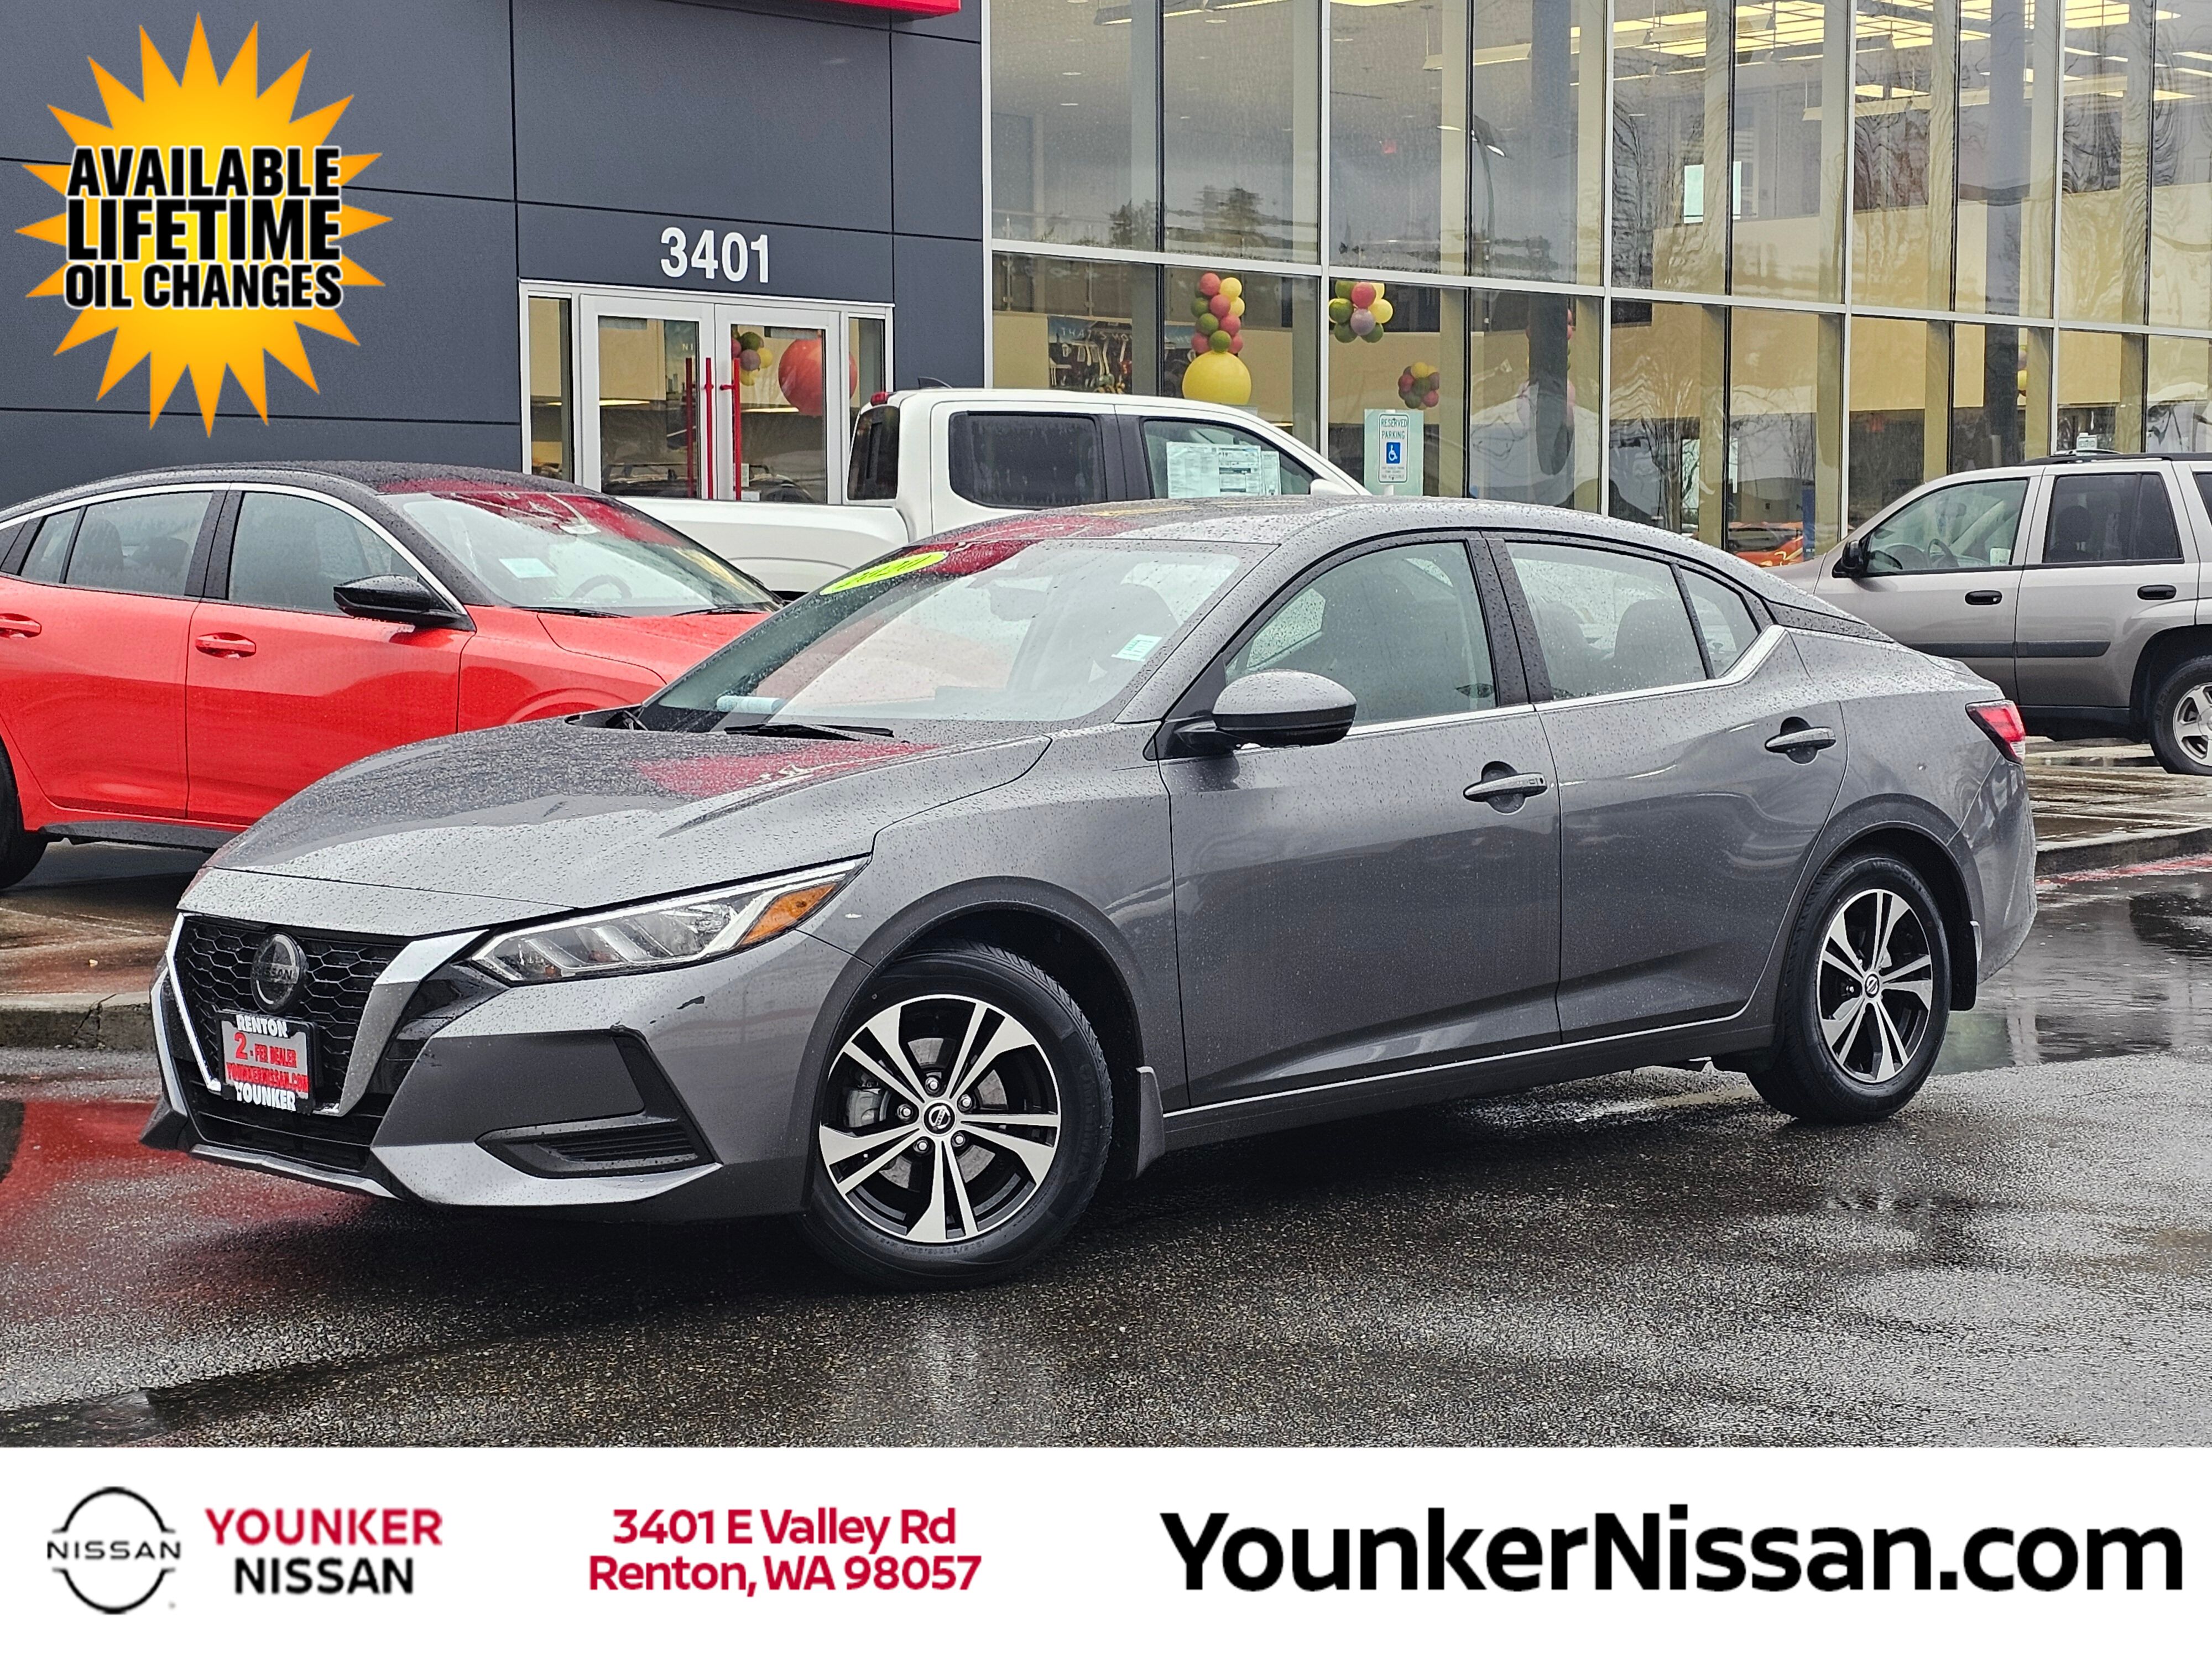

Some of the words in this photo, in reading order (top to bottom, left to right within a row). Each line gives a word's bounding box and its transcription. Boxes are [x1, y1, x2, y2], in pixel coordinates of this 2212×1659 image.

[660, 227, 769, 283] 3401
[1381, 418, 1408, 428] RESERVED
[1381, 430, 1405, 440] PARKING
[236, 1014, 288, 1038] RENTON
[269, 1046, 297, 1068] DEALER
[233, 1081, 297, 1112] YOUNKER
